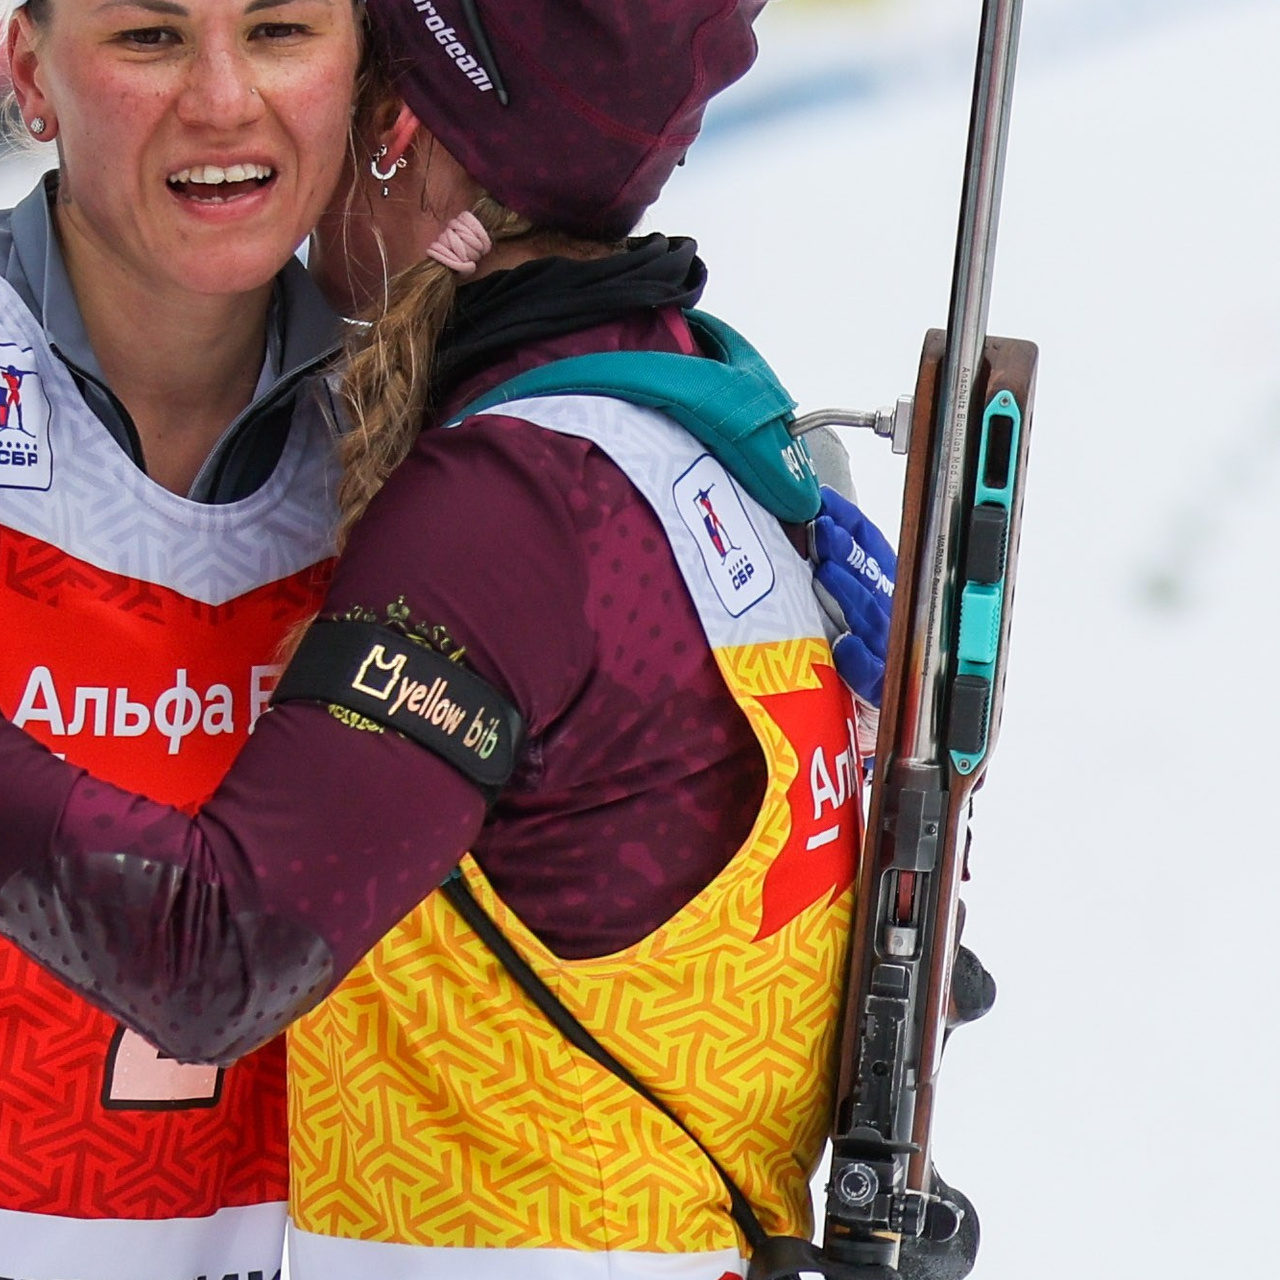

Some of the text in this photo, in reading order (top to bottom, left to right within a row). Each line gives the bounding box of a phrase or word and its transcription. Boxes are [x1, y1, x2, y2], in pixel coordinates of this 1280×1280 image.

[732, 562, 755, 591] СБР
[12, 666, 234, 754] Альфа
[388, 676, 500, 759] yellow bib
